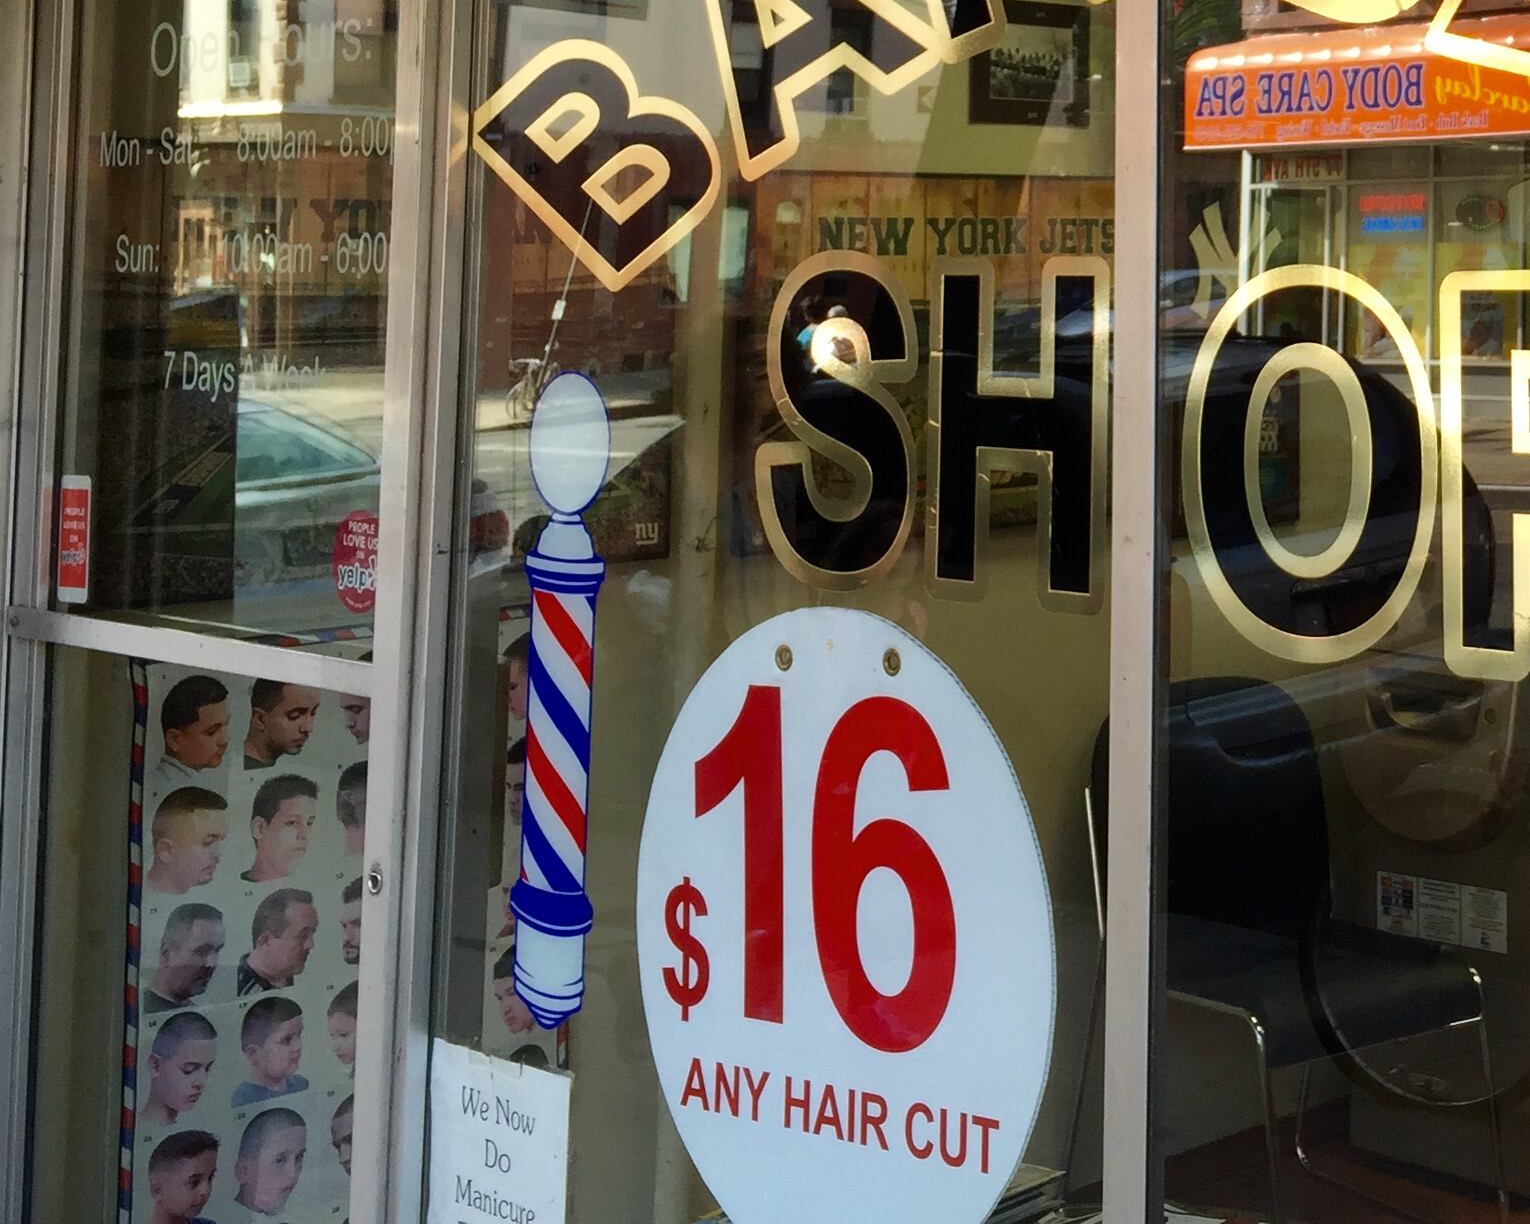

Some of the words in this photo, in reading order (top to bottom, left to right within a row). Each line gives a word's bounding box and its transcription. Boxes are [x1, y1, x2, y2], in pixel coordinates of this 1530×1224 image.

[99, 130, 140, 167] Mon
[236, 123, 316, 162] 8:00am
[115, 233, 160, 274] Sun:
[818, 216, 916, 255] NEW
[927, 215, 1027, 255] YORK
[1037, 214, 1115, 252] JETS
[163, 350, 176, 390] 7
[181, 350, 236, 402] Days
[343, 533, 366, 549] LOVE
[367, 538, 379, 551] US
[348, 520, 376, 535] PEOPLE
[337, 561, 369, 594] yelp
[461, 1085, 490, 1122] We
[495, 1096, 536, 1136] Now
[680, 1057, 770, 1122] ANY
[783, 1076, 889, 1152] HAIR
[904, 1102, 1000, 1175] CUT
[484, 1138, 512, 1174] Do
[455, 1174, 536, 1224] Manicure
